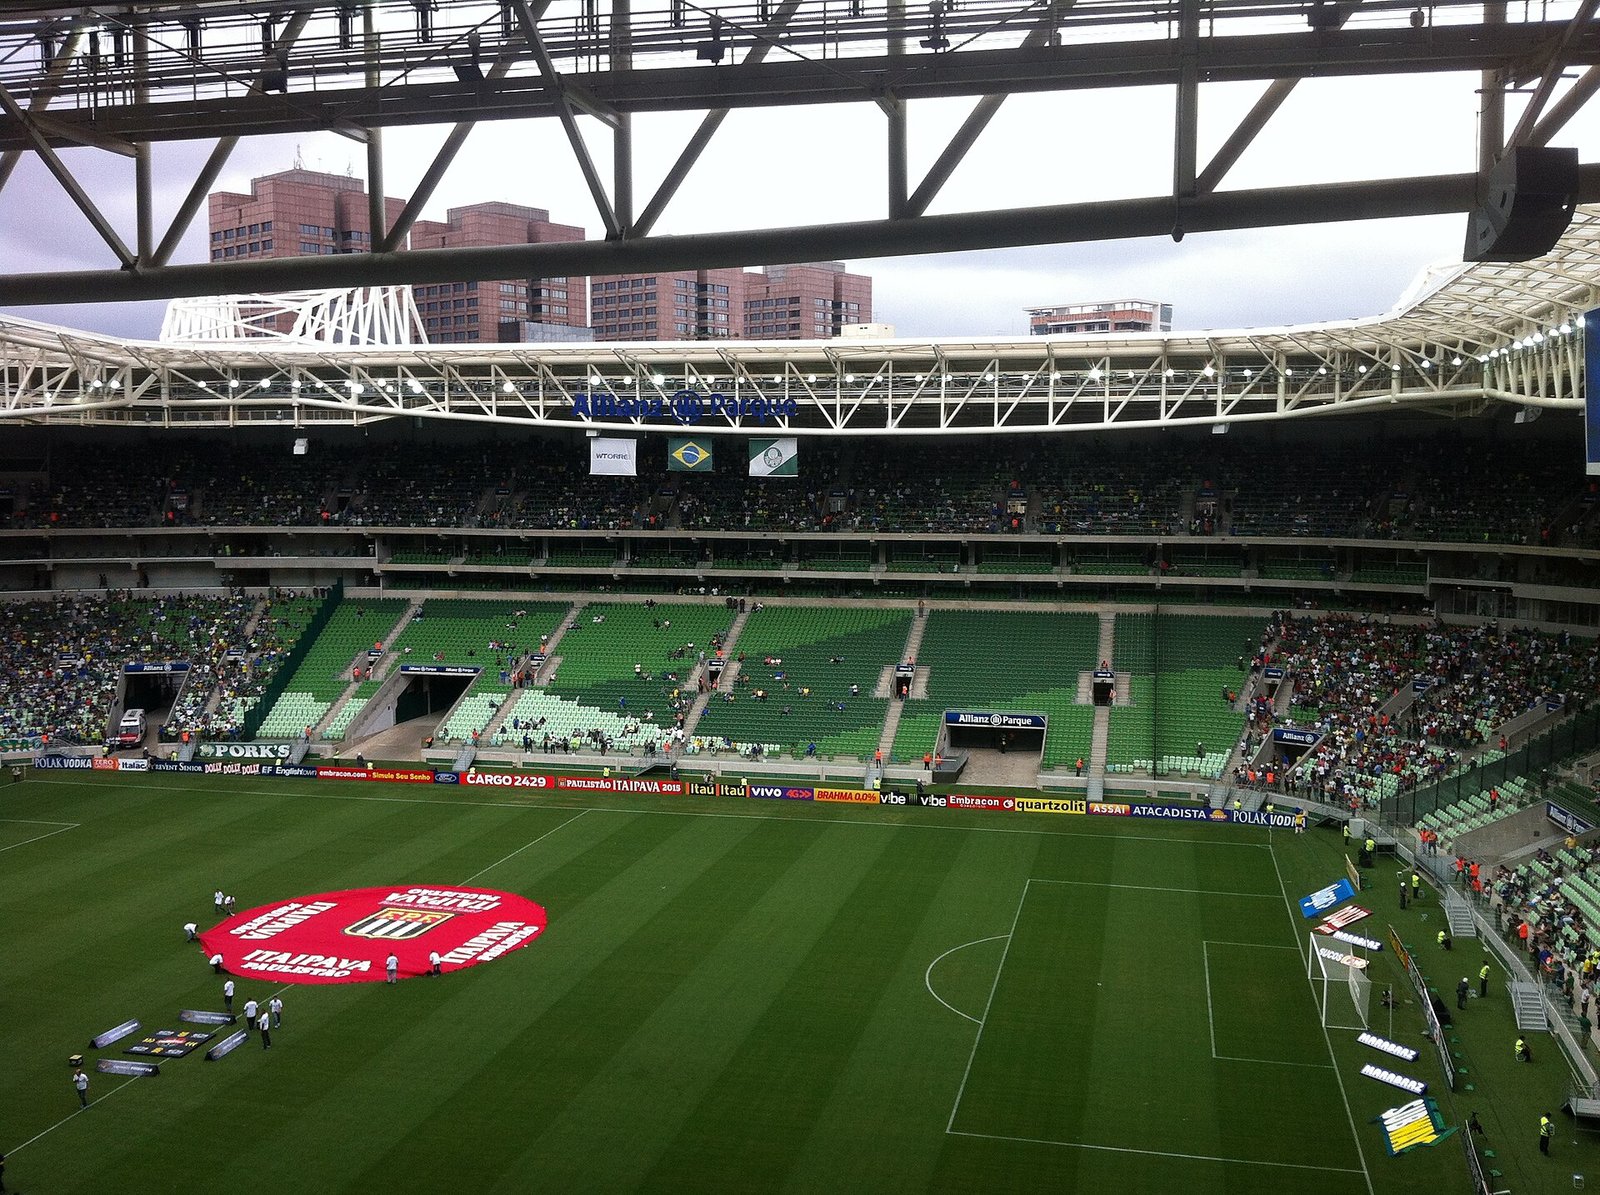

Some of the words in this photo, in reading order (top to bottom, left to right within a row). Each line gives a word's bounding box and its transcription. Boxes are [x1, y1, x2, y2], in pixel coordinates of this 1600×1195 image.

[572, 393, 664, 417] Allianz
[709, 393, 798, 425] Parque
[958, 714, 990, 724] Allianz
[1003, 716, 1032, 727] Parque
[1282, 732, 1305, 742] Allianz
[215, 744, 290, 759] PORK'S
[35, 757, 65, 769] POLAK
[64, 759, 92, 769] VODKA
[122, 761, 147, 769] Italac
[150, 762, 178, 771] REVENT
[204, 762, 222, 774] DOLLY
[223, 762, 241, 774] DOLLY
[241, 763, 260, 775] DOLLY
[262, 766, 273, 774] EF
[275, 766, 317, 777] Englishtown
[319, 770, 367, 780] embracon.com
[466, 773, 513, 786] CARGO
[513, 775, 547, 788] 2429
[566, 779, 611, 790] PAULISTÃO
[612, 779, 660, 793] ITAIPAVA
[662, 783, 681, 793] 2015
[690, 783, 715, 796] Itaú
[720, 785, 745, 798] Itaú
[817, 790, 854, 802] BRAHMA
[950, 796, 999, 806] Embracon
[1016, 799, 1085, 813] quartzolit
[1133, 806, 1207, 820] ATACADISTA
[1232, 811, 1269, 826] POLAK
[242, 949, 372, 972] ITAIPAVA
[1319, 947, 1344, 962] SUCOS
[1380, 1098, 1441, 1154] SUBWAY
